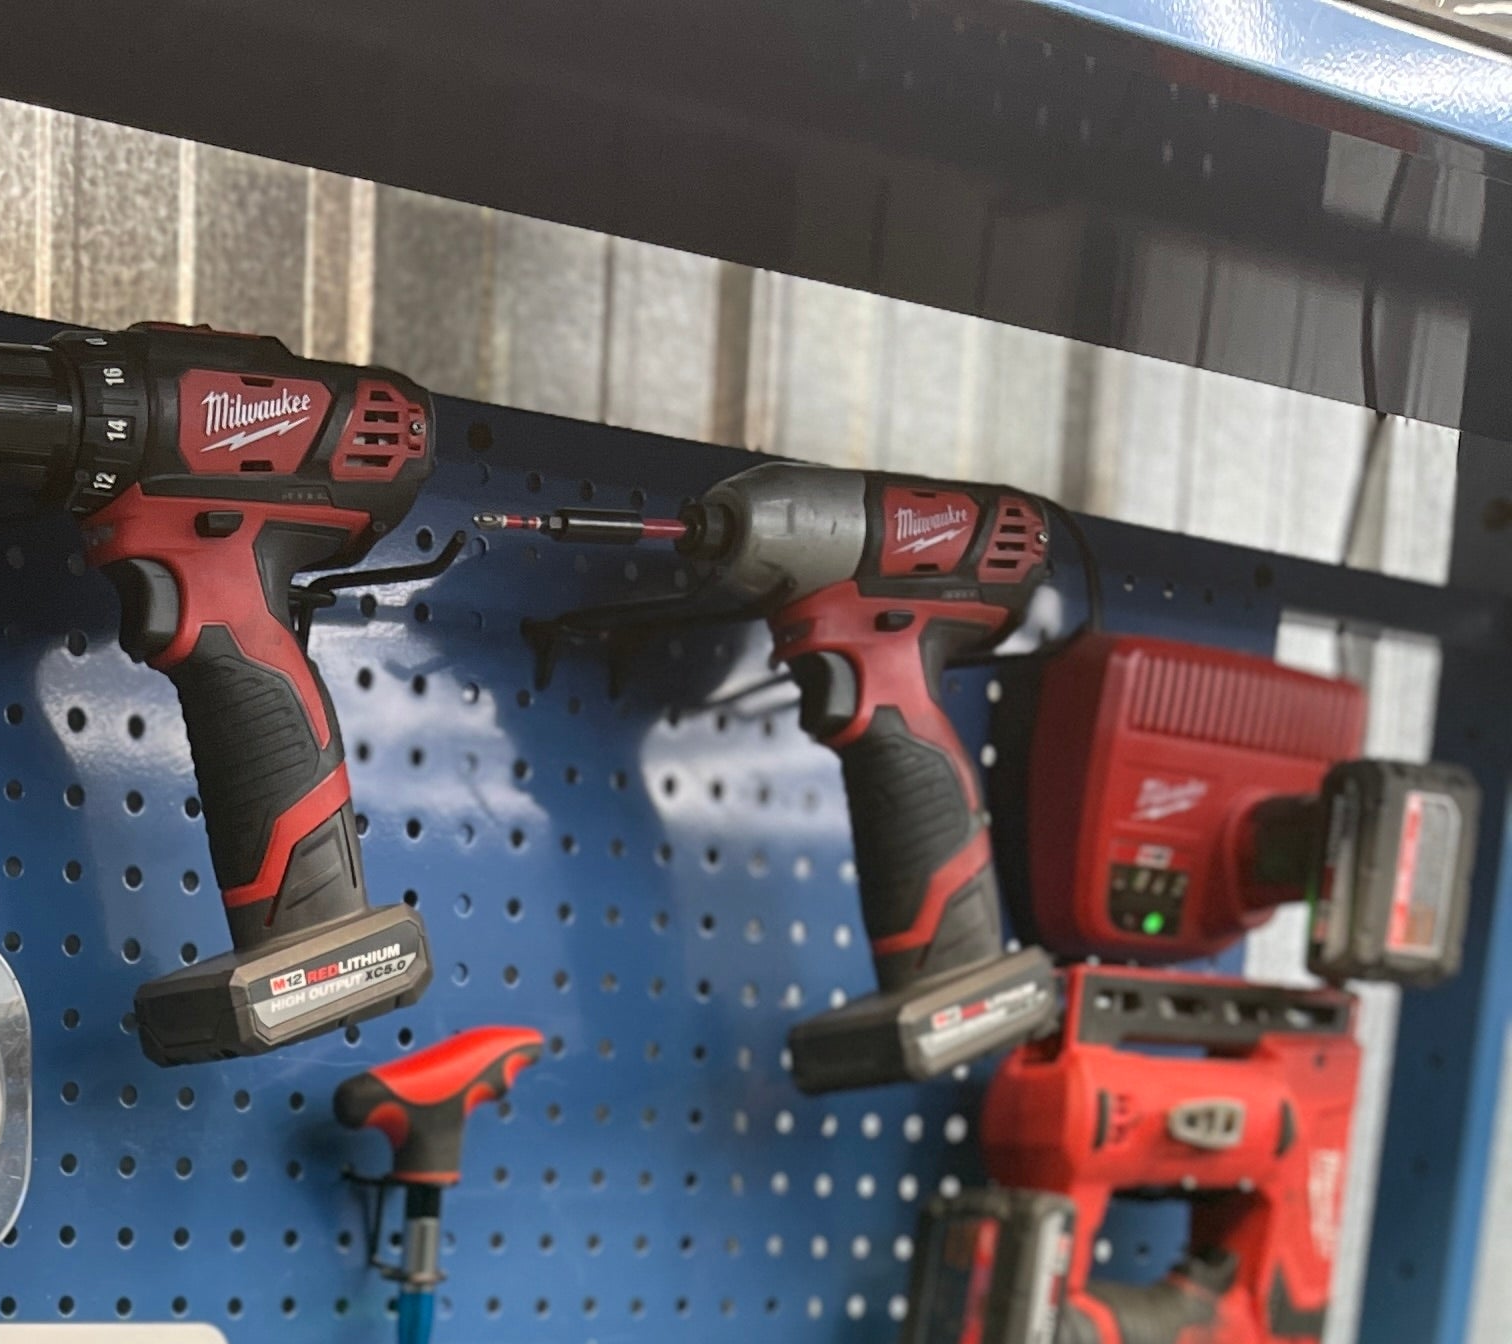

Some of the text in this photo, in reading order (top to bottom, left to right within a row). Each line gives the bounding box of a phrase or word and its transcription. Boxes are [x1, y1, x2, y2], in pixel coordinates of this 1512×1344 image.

[103, 367, 125, 387] 16
[201, 388, 311, 436] Milwaukee
[106, 419, 128, 442] 14
[93, 471, 117, 490] 12
[271, 959, 407, 1013] HIGH OUTPUT XC5.0
[272, 972, 303, 993] M12
